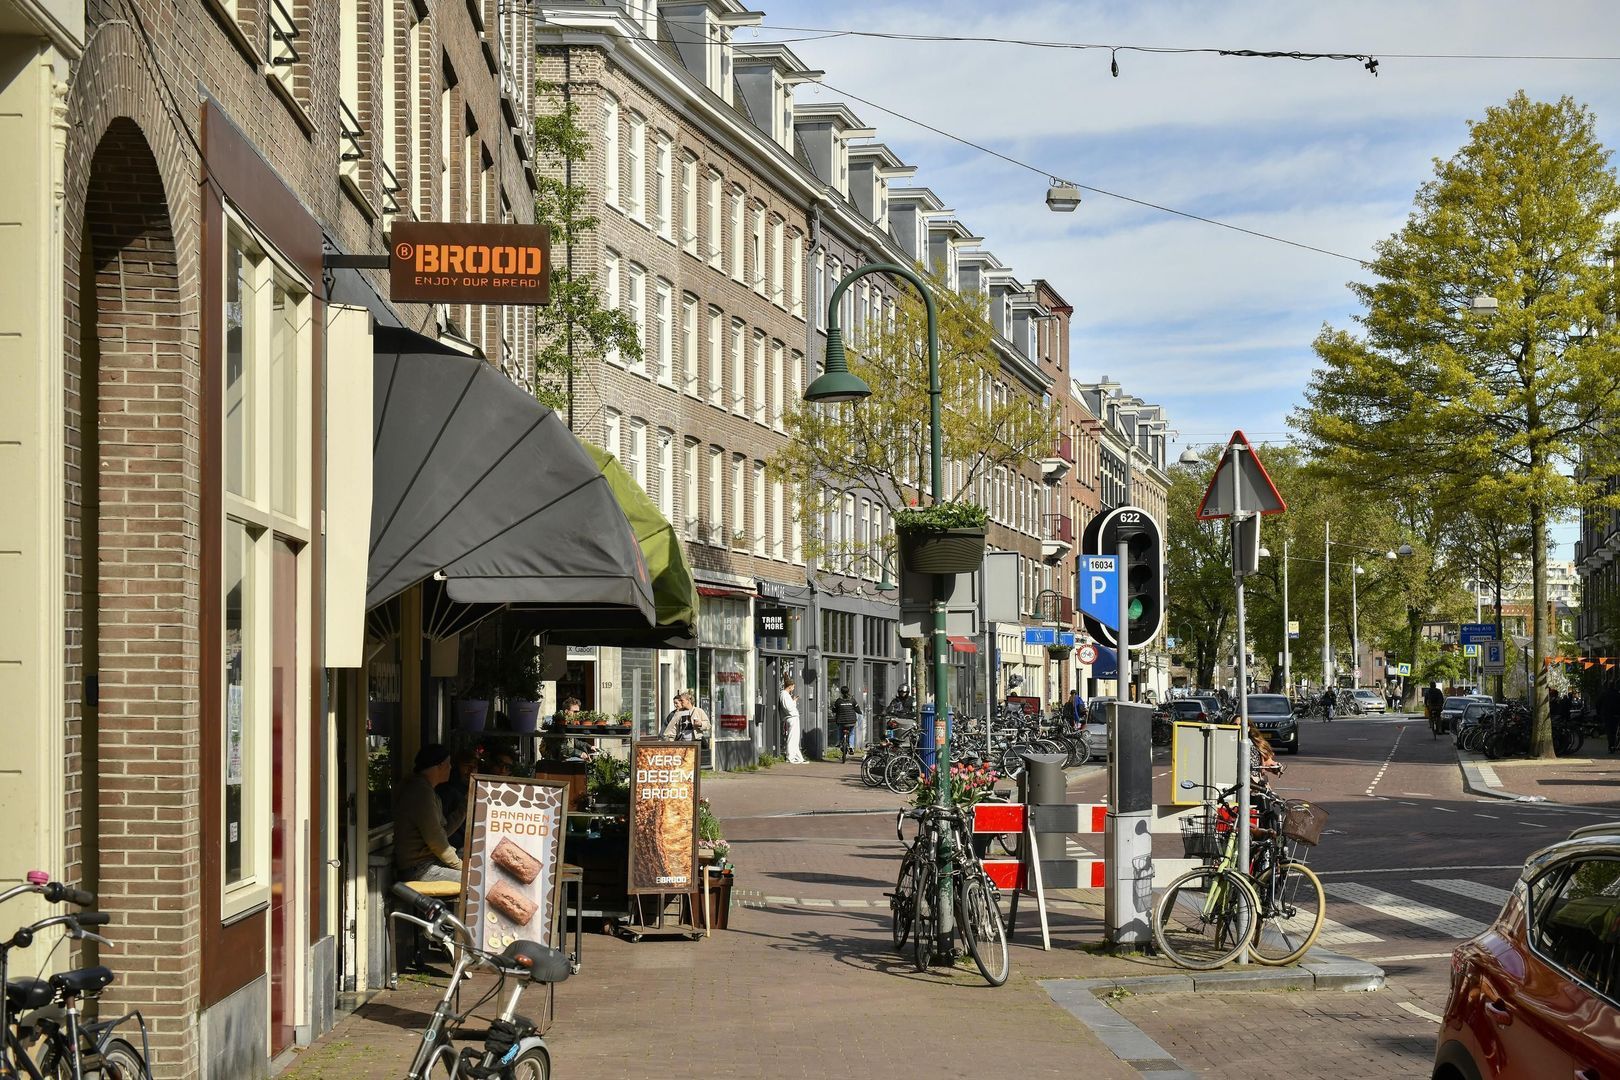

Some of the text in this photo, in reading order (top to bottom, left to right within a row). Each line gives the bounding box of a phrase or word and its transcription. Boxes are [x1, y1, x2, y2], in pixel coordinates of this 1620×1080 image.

[415, 244, 541, 275] BROOD
[415, 276, 540, 288] ENJOY OUR BREAD!
[1120, 512, 1140, 523] 622
[1090, 560, 1113, 569] 16034
[1091, 575, 1107, 605] P
[601, 681, 613, 689] 119
[647, 755, 682, 766] VERS
[636, 769, 694, 783] DESEM
[642, 788, 688, 799] BROOD
[491, 810, 550, 823] BANANEN
[490, 821, 549, 837] BROOD
